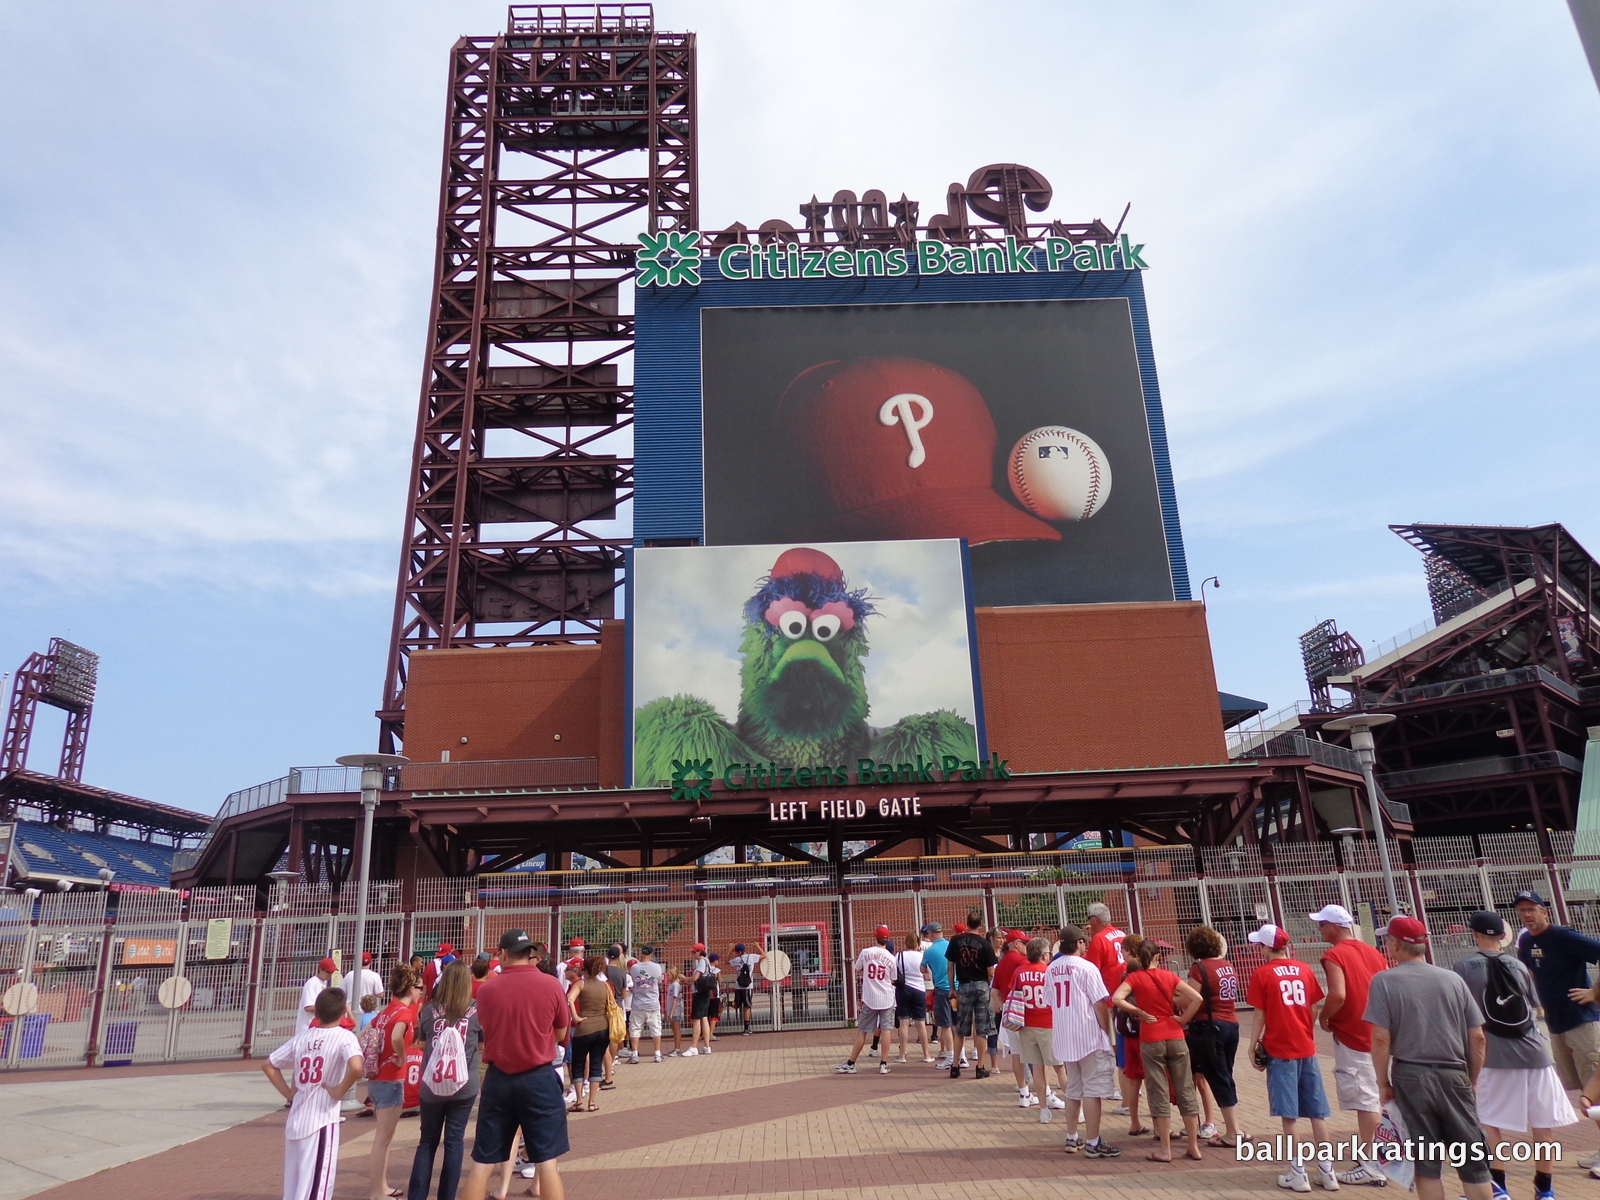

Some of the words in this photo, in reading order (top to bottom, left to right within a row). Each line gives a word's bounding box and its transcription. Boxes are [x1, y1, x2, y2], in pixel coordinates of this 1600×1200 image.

[718, 240, 908, 281] Citizens
[916, 235, 1036, 275] Bank
[1045, 233, 1149, 271] Park
[880, 393, 934, 469] P
[723, 761, 849, 790] Citizens
[857, 754, 934, 785] Bank
[941, 752, 1010, 782] Park
[770, 801, 808, 821] LEFT
[820, 799, 866, 819] FIELD
[878, 797, 922, 817] GATE
[868, 963, 886, 980] 95
[1020, 971, 1046, 982] UTLEY
[1051, 964, 1075, 977] ROLLINS
[1215, 966, 1234, 977] UTLEY
[1273, 965, 1300, 976] UTLEY
[1023, 985, 1047, 1008] 26
[1054, 980, 1071, 1008] 11
[1219, 976, 1237, 1000] 26
[1279, 979, 1306, 1006] 26
[307, 1040, 324, 1051] LEE
[299, 1055, 325, 1084] 33
[408, 1065, 419, 1084] 6
[432, 1059, 458, 1083] 34
